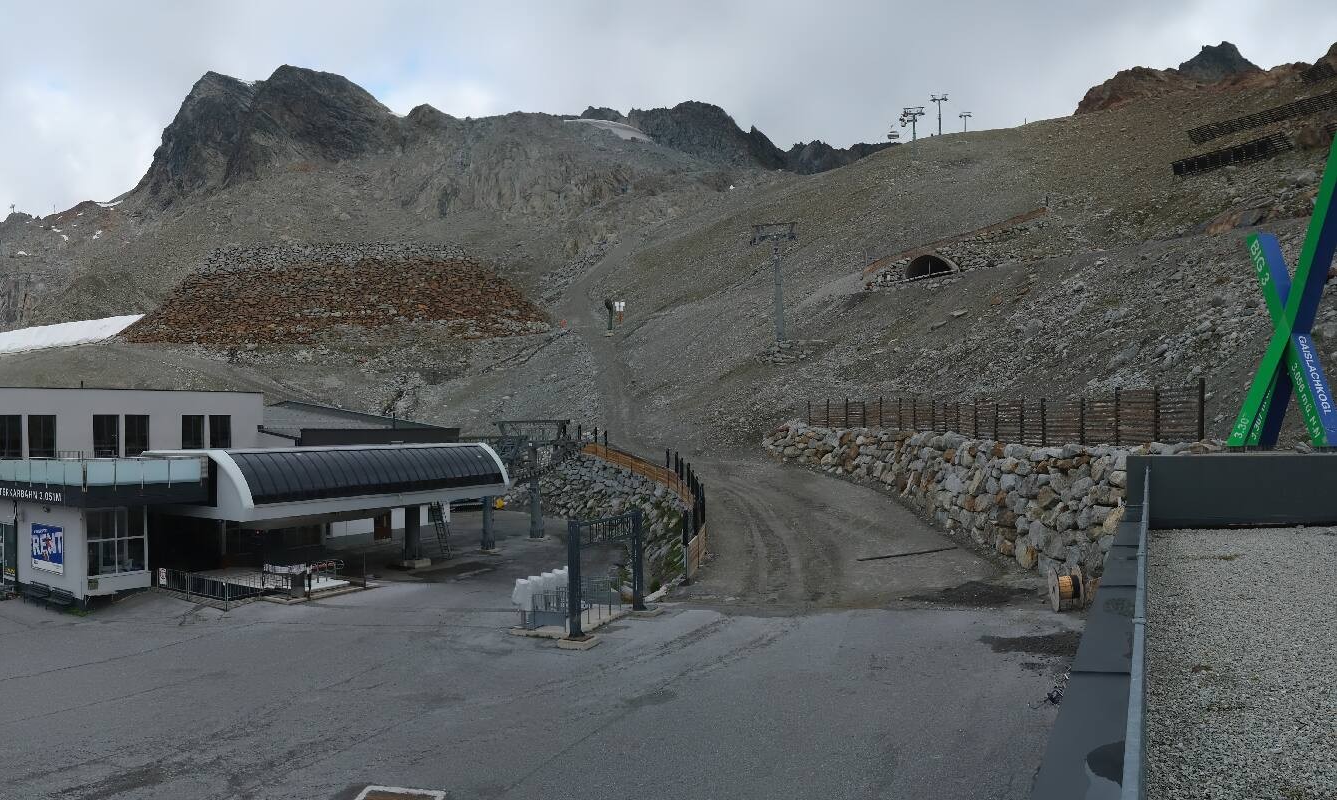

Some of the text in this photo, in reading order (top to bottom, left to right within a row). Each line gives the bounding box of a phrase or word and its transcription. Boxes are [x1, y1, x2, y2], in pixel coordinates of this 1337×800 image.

[1250, 239, 1270, 286] BIG 3
[1298, 335, 1331, 415] GAISLACHKOGL
[32, 532, 63, 556] RENT
